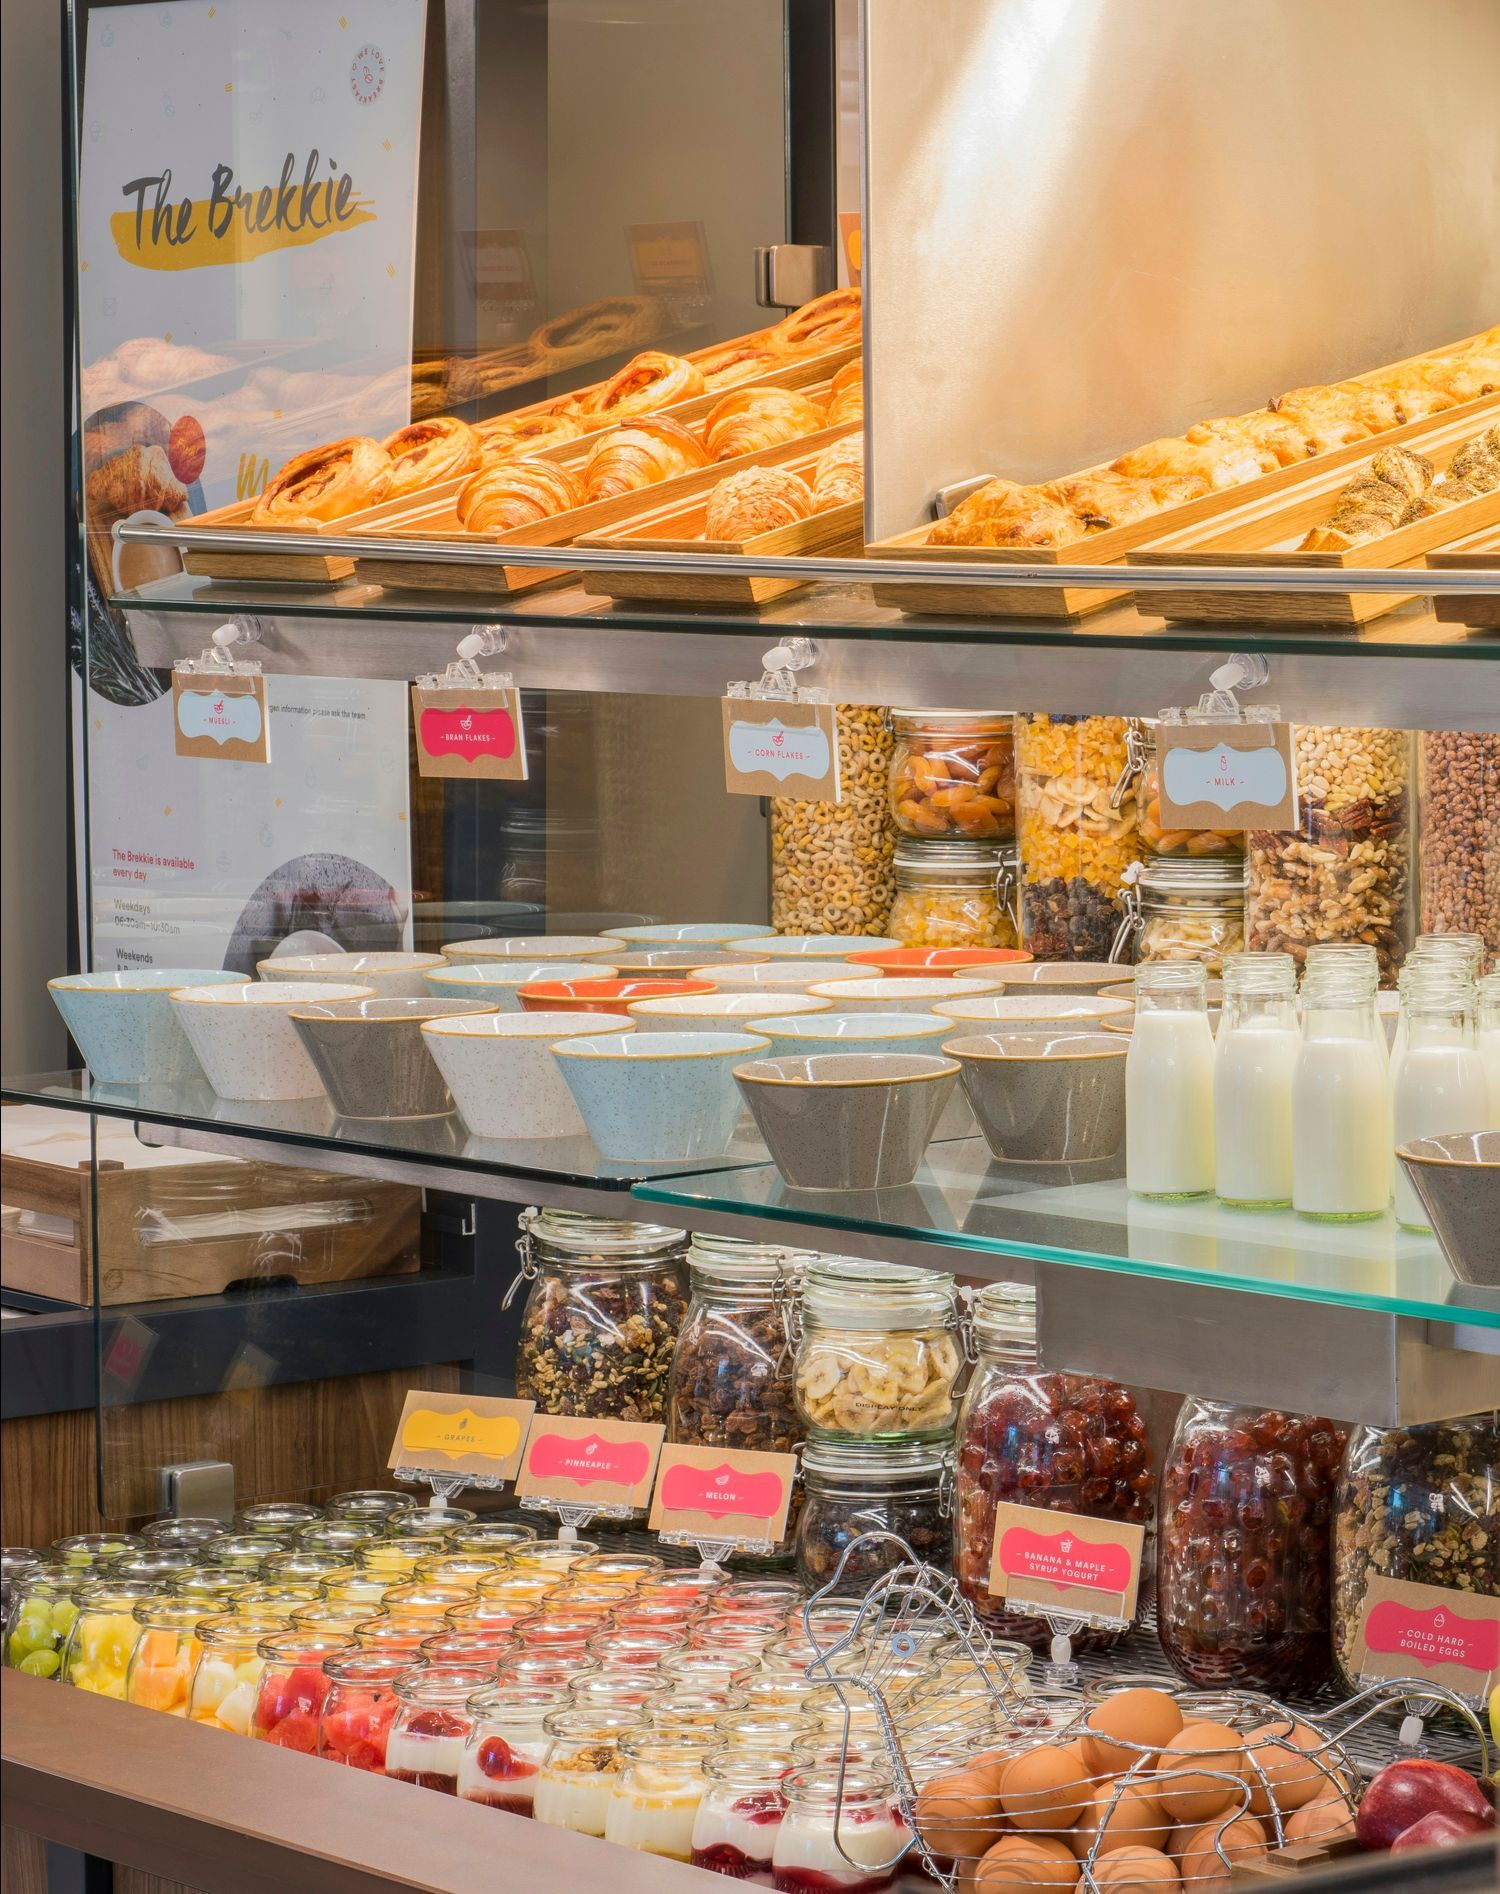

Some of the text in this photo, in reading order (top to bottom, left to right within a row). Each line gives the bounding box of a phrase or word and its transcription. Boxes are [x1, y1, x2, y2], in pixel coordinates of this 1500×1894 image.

[122, 149, 362, 250] The Brekkie
[445, 733, 491, 742] BRAN FLAKES
[755, 748, 804, 760] CORN FLAKES
[1214, 778, 1235, 786] MILK
[112, 848, 195, 870] The Brekkie is available
[112, 868, 148, 882] every day
[113, 898, 151, 916] Weekdays
[115, 947, 153, 964] Weekends
[444, 1434, 476, 1443] GRAPES
[564, 1459, 612, 1470] PINNEAPLE
[705, 1491, 736, 1501] MELON
[1024, 1551, 1062, 1564] BANANA
[1074, 1560, 1106, 1573] MAPLE
[1029, 1562, 1099, 1581] SYRUP YOGURT
[1406, 1629, 1464, 1647] COLD HARD
[1400, 1639, 1465, 1658] BOILED EGGS
